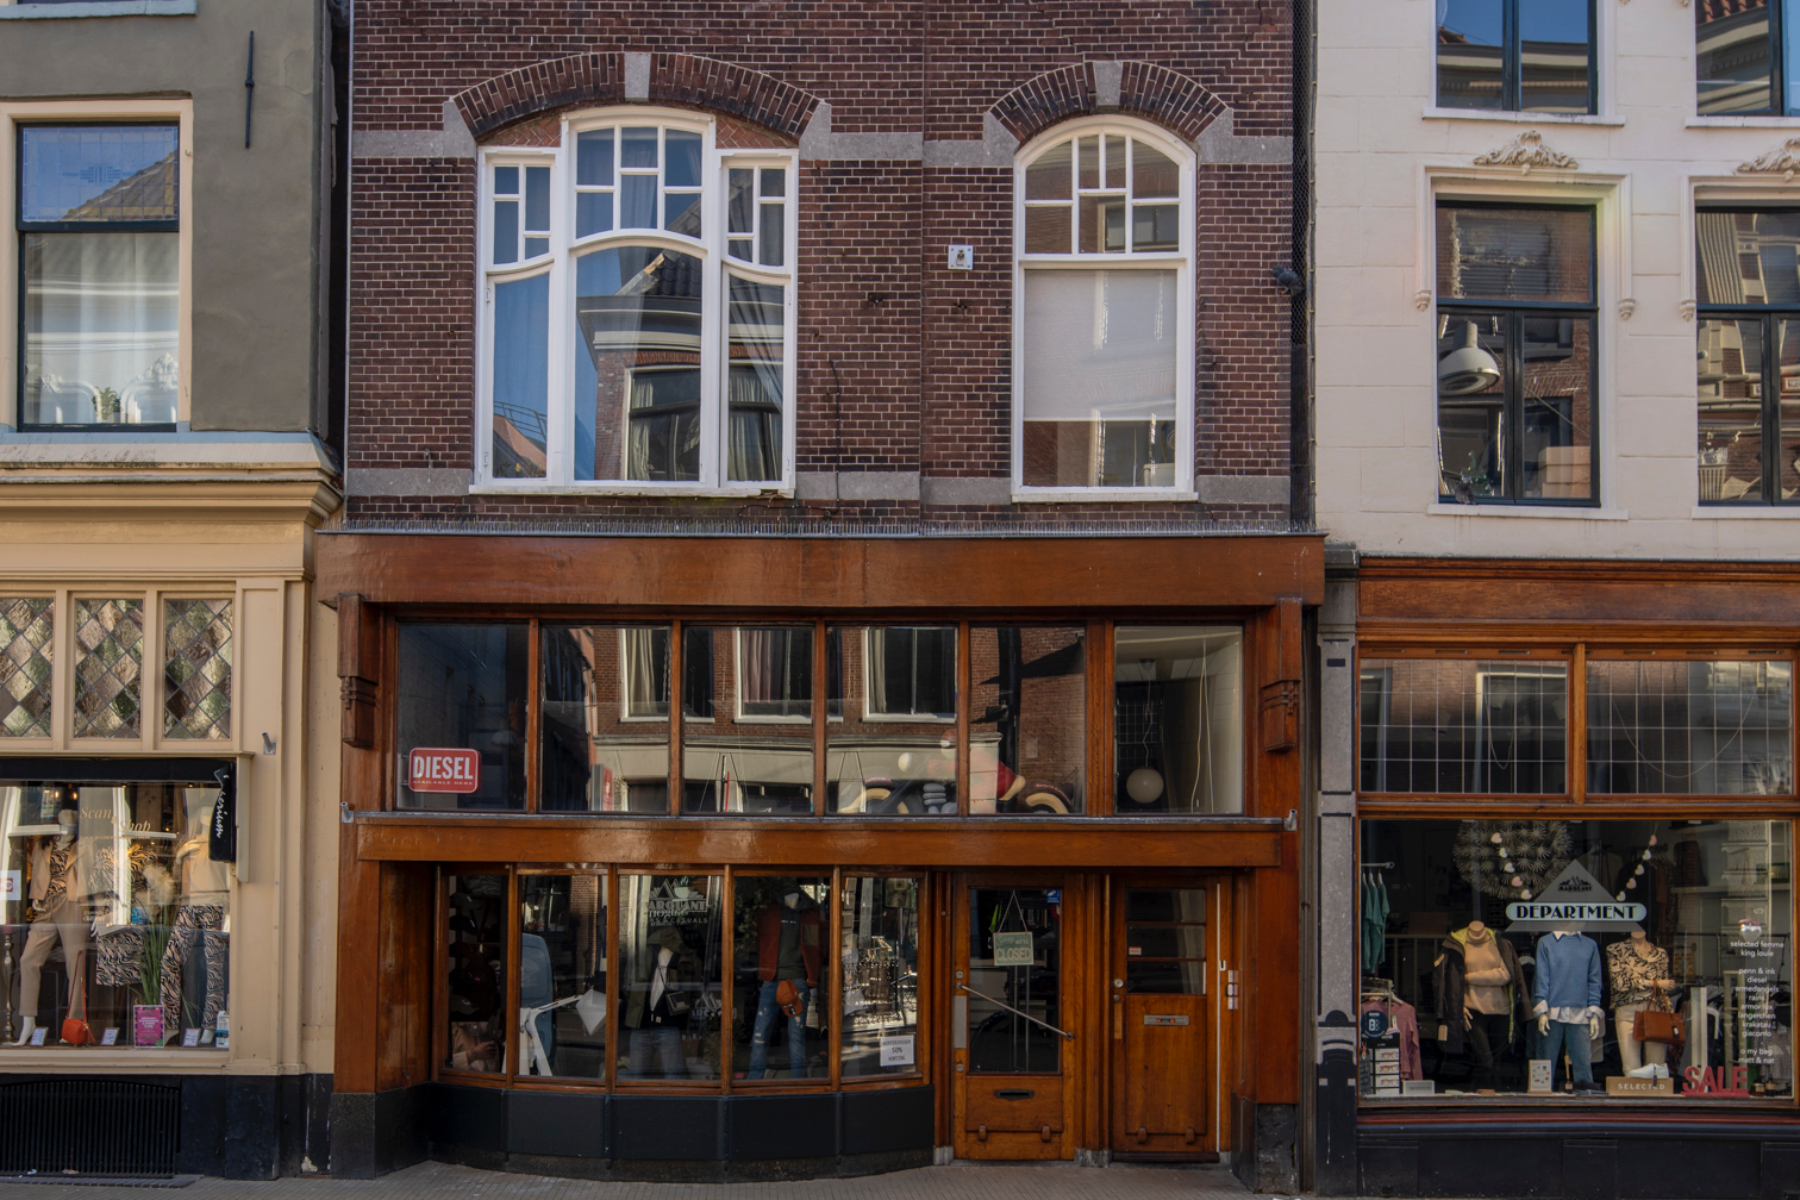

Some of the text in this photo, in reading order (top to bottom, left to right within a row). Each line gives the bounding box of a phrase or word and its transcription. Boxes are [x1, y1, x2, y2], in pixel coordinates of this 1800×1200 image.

[412, 755, 473, 779] DIESEL
[80, 806, 112, 819] Scan
[120, 818, 151, 836] Shop
[1516, 905, 1637, 919] DEPARTMENT
[1730, 940, 1785, 949] selected femme
[997, 947, 1031, 961] CLOSED
[1741, 949, 1775, 958] king louie
[1738, 967, 1776, 976] penn & ink
[1742, 1029, 1772, 1039] giacomo
[1759, 1047, 1773, 1056] bag
[1682, 1065, 1749, 1095] SALE
